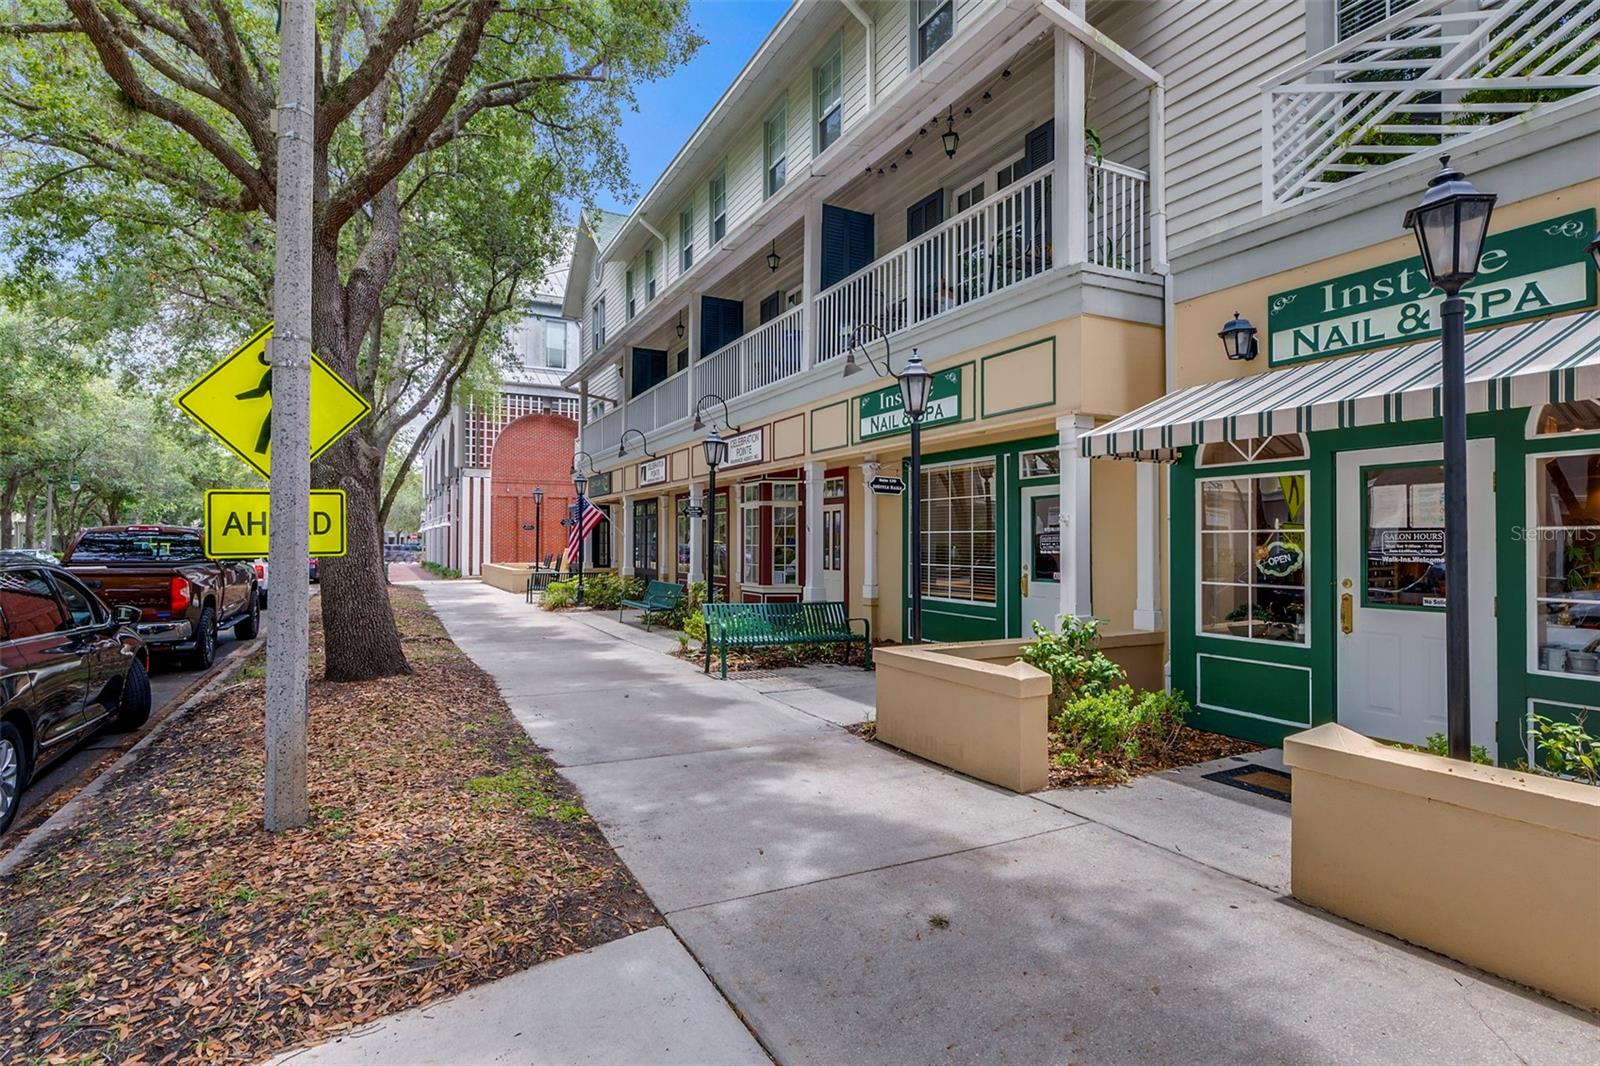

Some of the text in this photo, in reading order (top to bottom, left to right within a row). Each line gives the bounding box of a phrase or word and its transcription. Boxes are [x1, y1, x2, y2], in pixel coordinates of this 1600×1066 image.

[1320, 249, 1509, 314] Instye
[1293, 318, 1386, 356] NAIL
[1397, 302, 1430, 334] &
[870, 415, 900, 433] NAIL
[730, 433, 760, 449] CELEBRATION
[222, 511, 332, 536] AHD
[1268, 554, 1291, 566] OPEN
